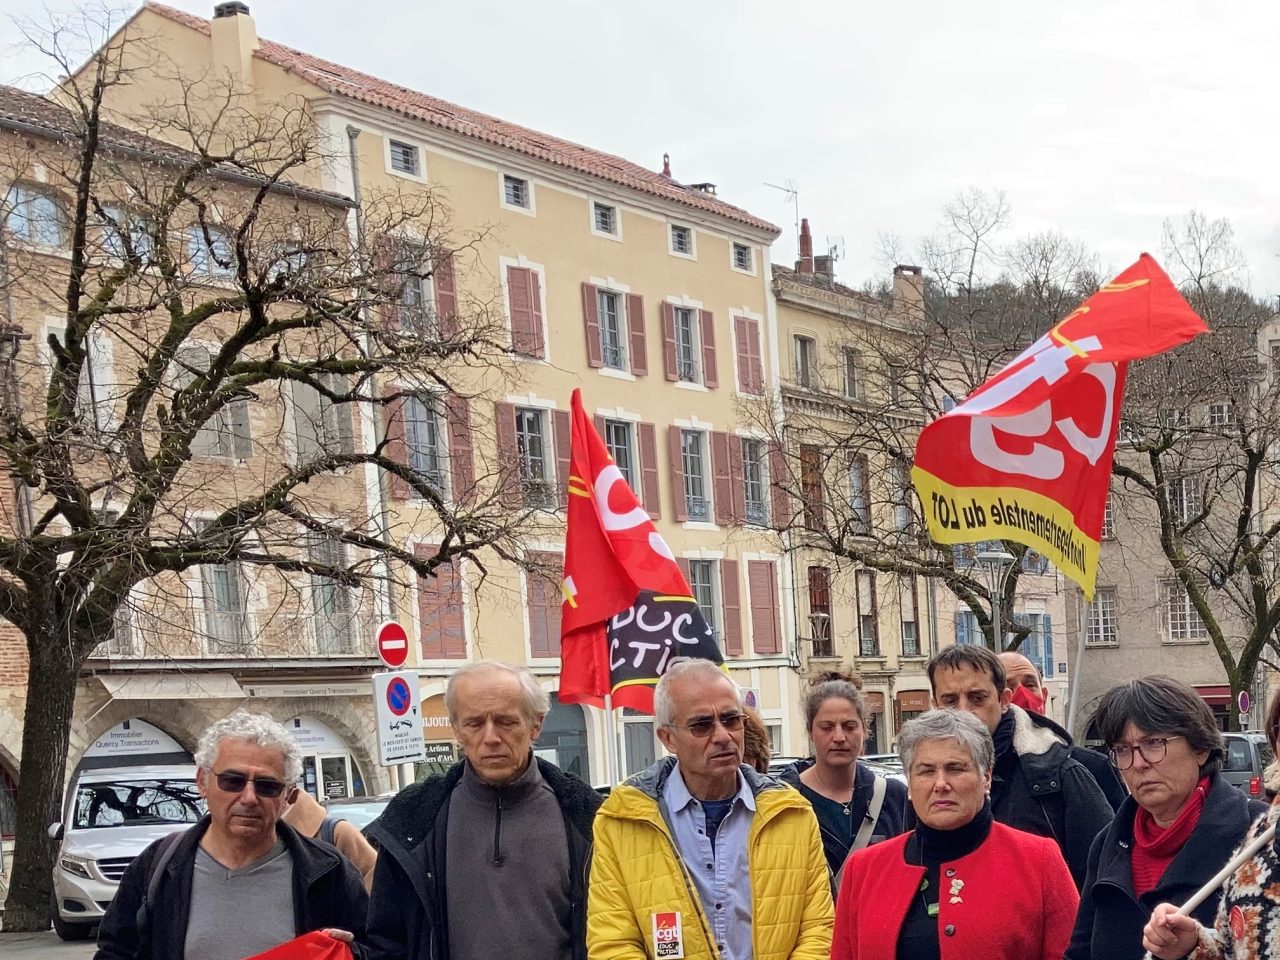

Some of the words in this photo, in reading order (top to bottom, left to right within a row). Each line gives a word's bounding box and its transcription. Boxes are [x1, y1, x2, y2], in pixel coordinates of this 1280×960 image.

[110, 731, 143, 739] Immobilier
[95, 741, 119, 749] Quercy
[120, 739, 160, 748] Transactions
[657, 925, 678, 941] cgt
